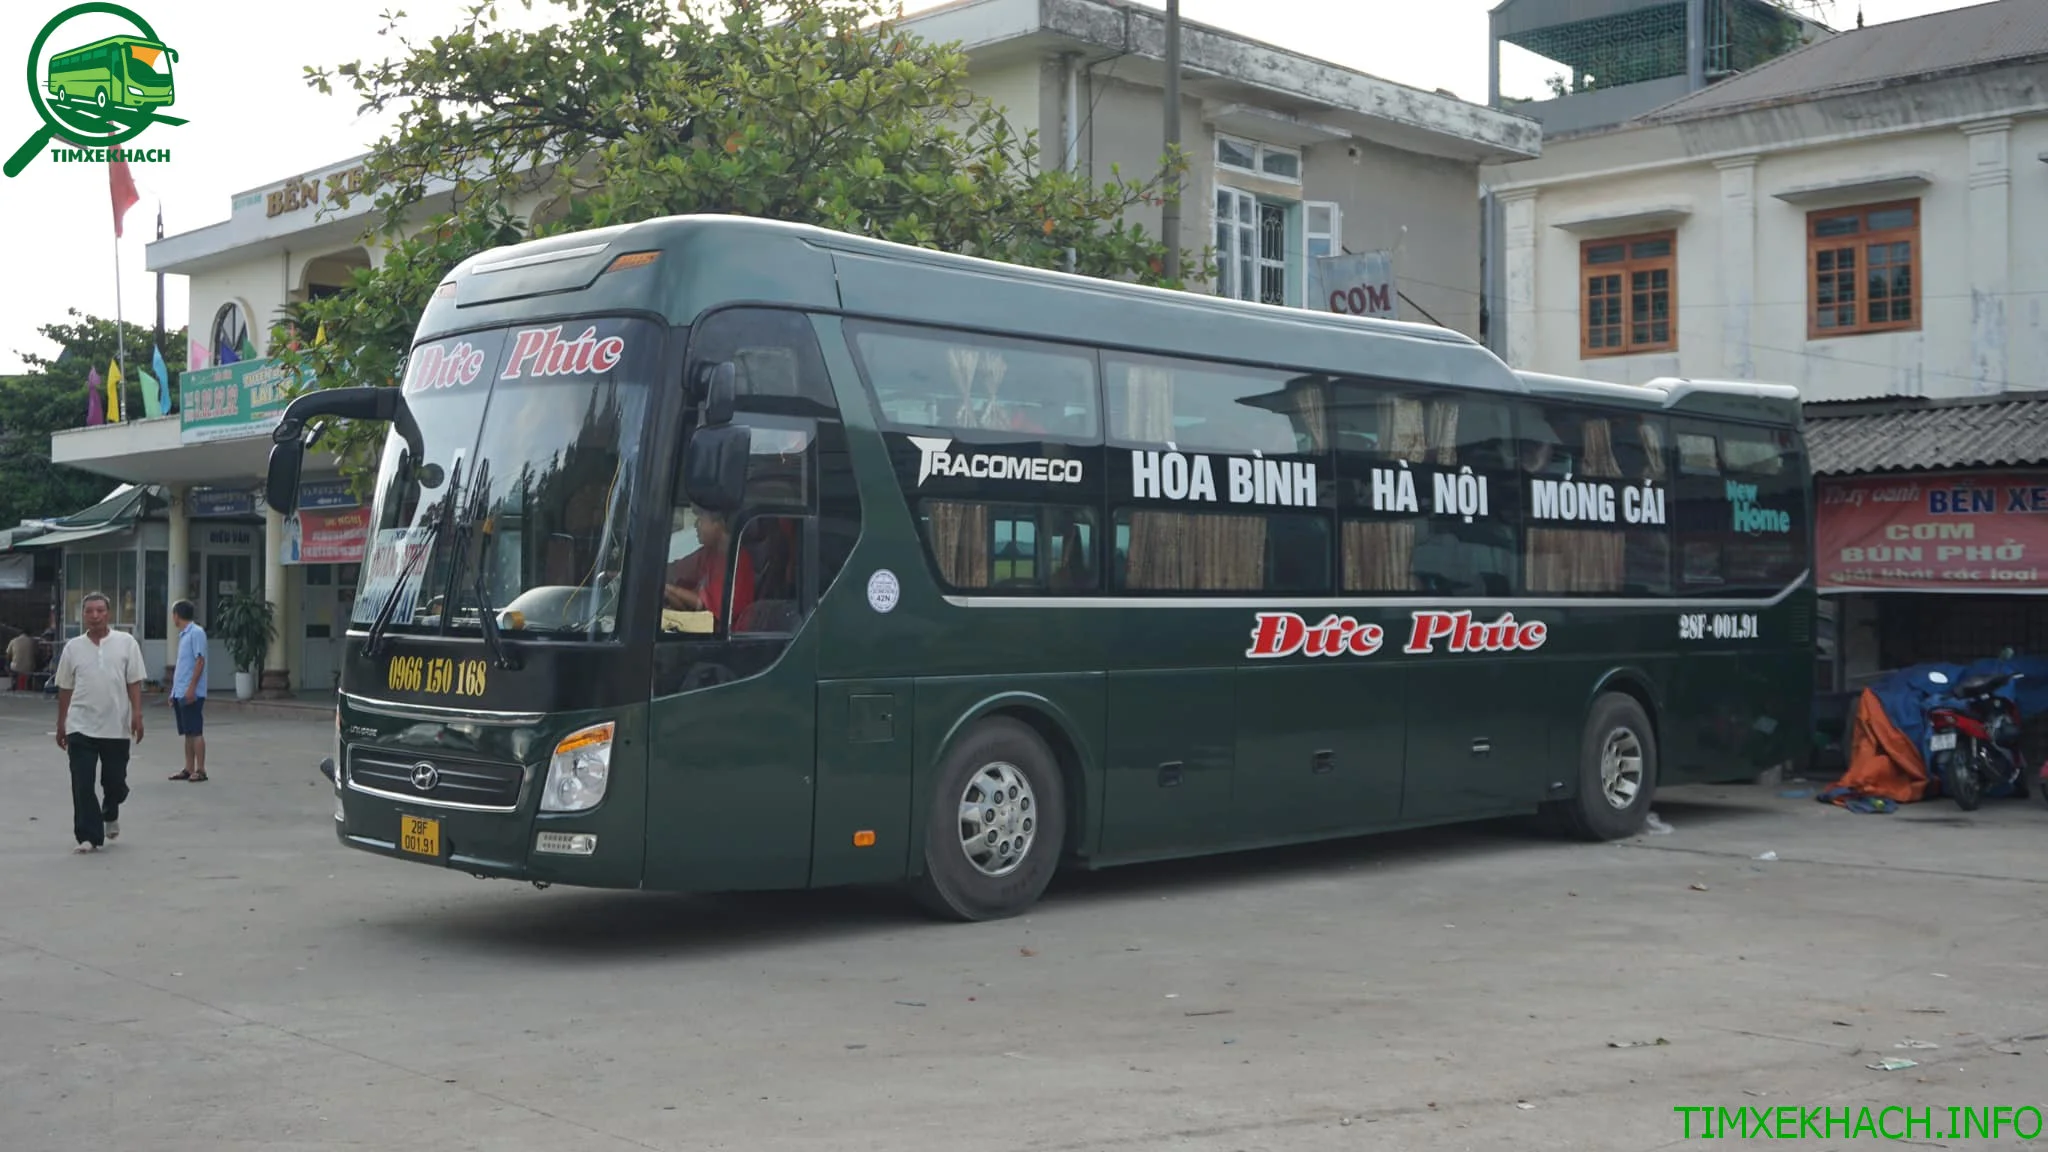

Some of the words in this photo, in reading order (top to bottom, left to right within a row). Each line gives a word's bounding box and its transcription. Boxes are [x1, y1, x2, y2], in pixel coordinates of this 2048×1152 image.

[266, 175, 320, 218] BẾN
[1330, 283, 1391, 314] CƠM
[409, 341, 485, 394] Đức
[501, 325, 624, 380] Phúc
[907, 436, 1083, 487] TRACOMECO
[1132, 441, 1217, 502] HÒA
[1228, 449, 1317, 507] BÌNH
[1372, 459, 1418, 513] HÀ
[1433, 465, 1489, 524] NỘI
[1531, 473, 1616, 523] MÓNG
[1622, 479, 1666, 525] CÁI
[1725, 479, 1758, 502] New
[1928, 479, 1997, 514] BẾN
[2005, 485, 2048, 514] XE
[1733, 500, 1790, 534] Home
[1886, 522, 1975, 541] CƠM
[1840, 543, 1924, 563] BÚN
[1936, 538, 2027, 562] PHỞ
[1246, 612, 1384, 658] Đức
[1404, 610, 1548, 654] Phúc
[1679, 613, 1760, 640] 28F-001.91
[388, 656, 423, 691] 0966
[424, 658, 454, 695] 150
[455, 660, 488, 697] 168
[405, 834, 435, 854] 001.91
[411, 820, 428, 835] 28F
